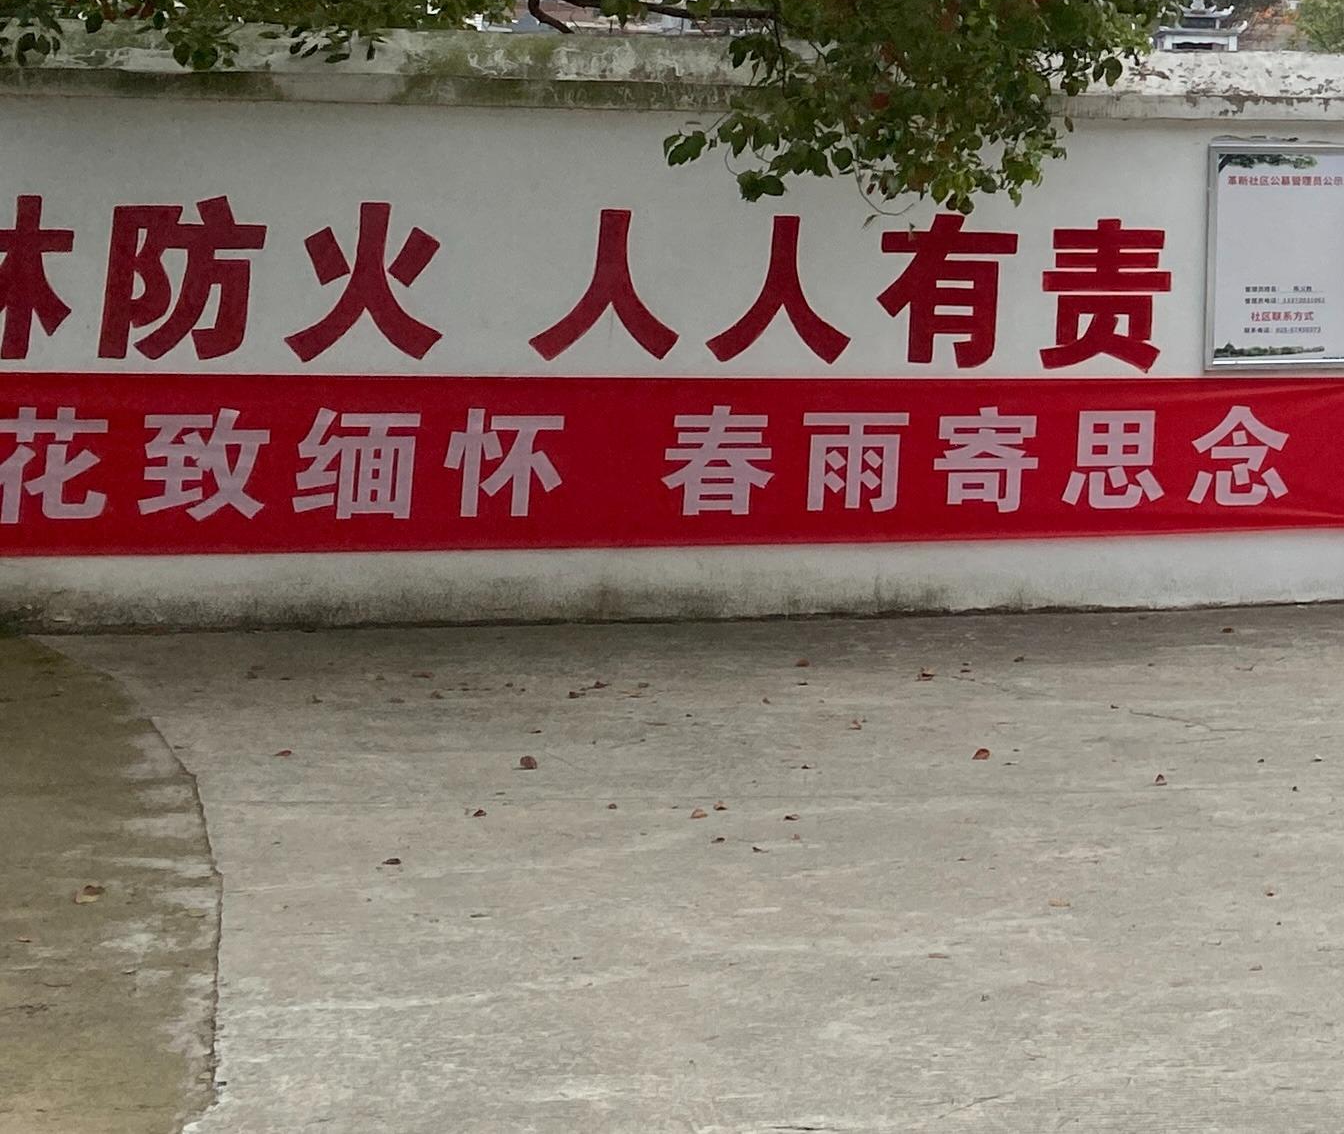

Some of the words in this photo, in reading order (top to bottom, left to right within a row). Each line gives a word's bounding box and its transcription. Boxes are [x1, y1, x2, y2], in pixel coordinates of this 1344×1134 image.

[529, 209, 1172, 374] 人人有责
[1250, 311, 1315, 322] 社区联系方式
[0, 407, 565, 523] 花致缅怀
[661, 405, 1290, 516] 春雨寄思念
